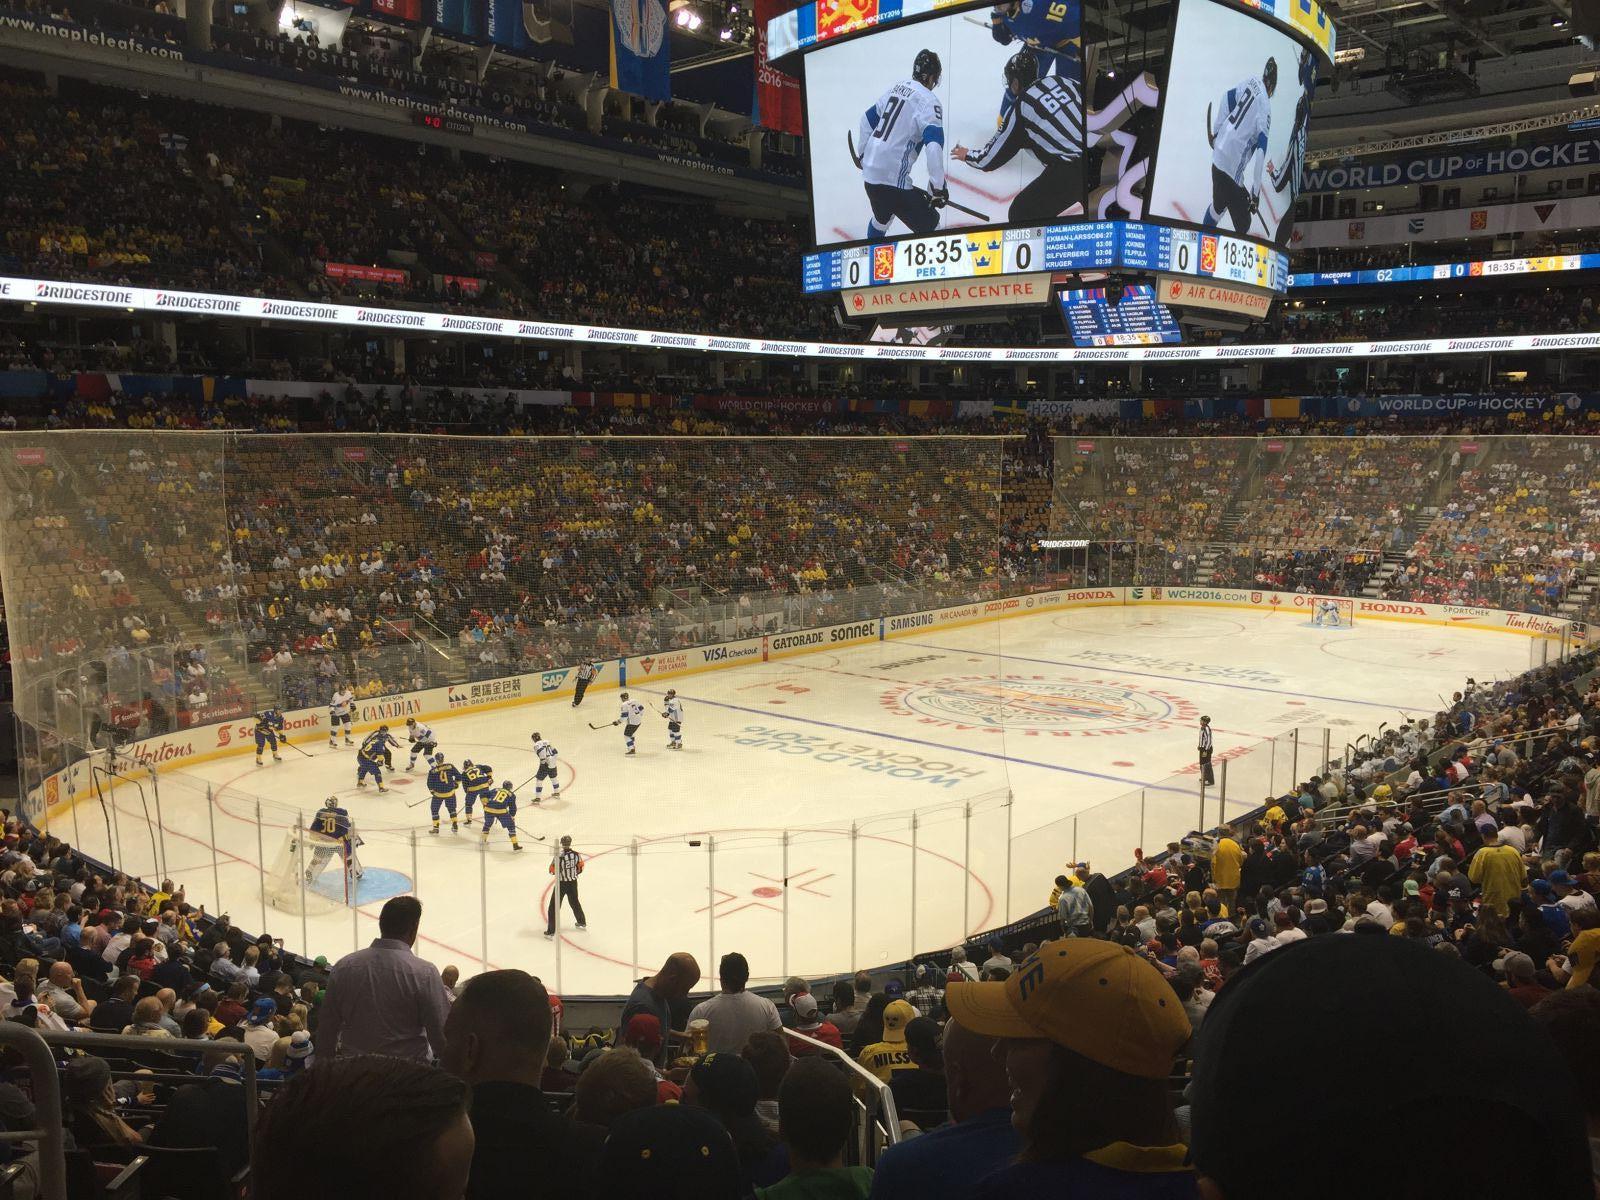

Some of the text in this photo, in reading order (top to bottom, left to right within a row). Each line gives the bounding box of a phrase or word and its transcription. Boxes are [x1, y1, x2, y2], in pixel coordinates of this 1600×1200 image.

[254, 36, 559, 114] THE FOSTER HEWITT MEDIA GONDOLA
[758, 70, 782, 88] 2016
[1039, 85, 1071, 114] 65
[658, 153, 735, 177] www.raptors.com
[1303, 164, 1402, 191] WORLD
[1406, 156, 1464, 181] CUP
[1464, 158, 1486, 171] OF
[1005, 229, 1031, 242] SHOTS
[1046, 224, 1094, 235] HJALMARSSON
[843, 248, 860, 260] SHOTS
[904, 239, 962, 268] 18:35
[1046, 243, 1074, 251] HAGELIN
[1016, 243, 1031, 270] 0
[1046, 251, 1090, 260] SILFVERBERG
[1178, 245, 1188, 271] 0
[1223, 241, 1254, 269] 18:35
[1046, 260, 1073, 268] KRUGER
[1456, 265, 1464, 277] 0
[1487, 260, 1516, 274] 18:35
[849, 261, 860, 286] 0
[916, 267, 946, 278] PER 2
[1320, 271, 1352, 281] FACEOFFS
[1377, 269, 1393, 282] 62
[38, 283, 133, 304] BRIDGESTONE
[871, 283, 1034, 306] AIR CANADA CENTRE
[1187, 286, 1268, 310] AIR CANADA CENTRE
[157, 292, 242, 316] BRIDGESTONE
[263, 301, 339, 320] BRIDGESTONE
[358, 309, 426, 328] BRIDGESTONE
[442, 317, 504, 333] BRIDGESTONE
[518, 323, 574, 338] BRIDGESTONE
[587, 329, 639, 343] BRIDGESTONE
[650, 333, 697, 347] BRIDGESTONE
[707, 338, 751, 350] BRIDGESTONE
[1116, 334, 1137, 343] 18:35
[1448, 338, 1514, 350] BRIDGESTONE
[1531, 335, 1600, 348] BRIDGESTONE
[760, 342, 807, 354] BRIDGESTONE
[817, 345, 865, 357] BRIDGESTONE
[877, 348, 926, 358] BRIDGESTONE
[939, 349, 992, 359] BRIDGESTONE
[1005, 350, 1060, 359] BRIDGESTONE
[1073, 350, 1129, 359] BRIDGESTONE
[1143, 348, 1202, 359] BRIDGESTONE
[1215, 347, 1276, 357] BRIDGESTONE
[1291, 344, 1354, 355] BRIDGESTONE
[1369, 342, 1432, 354] BRIDGESTONE
[718, 400, 753, 411] WORLD
[753, 400, 773, 411] CUP
[780, 400, 820, 411] HOCKEY
[1379, 399, 1434, 411] WORLD
[1435, 398, 1467, 410] CUP
[1478, 397, 1546, 410] HOCKEY
[1038, 539, 1090, 548] BRIDGESTONE
[1067, 590, 1116, 602] HONDA
[1167, 589, 1247, 602] WCH2016.COM
[949, 607, 972, 621] CANADA
[1359, 601, 1428, 616] HONDA
[890, 613, 934, 631] SAMSUNG
[1505, 612, 1526, 628] Tim
[830, 621, 876, 644] sonnet
[772, 631, 824, 651] GATORADE
[703, 646, 758, 663] VISA Checkout
[542, 672, 565, 688] SAP
[486, 691, 522, 702] PACKAGING
[202, 705, 243, 721] Scotiabank
[363, 698, 422, 723] CANADIAN
[238, 714, 320, 740] Scbank
[466, 767, 483, 781] 62
[813, 752, 961, 788] WORLD
[492, 789, 508, 803] 18
